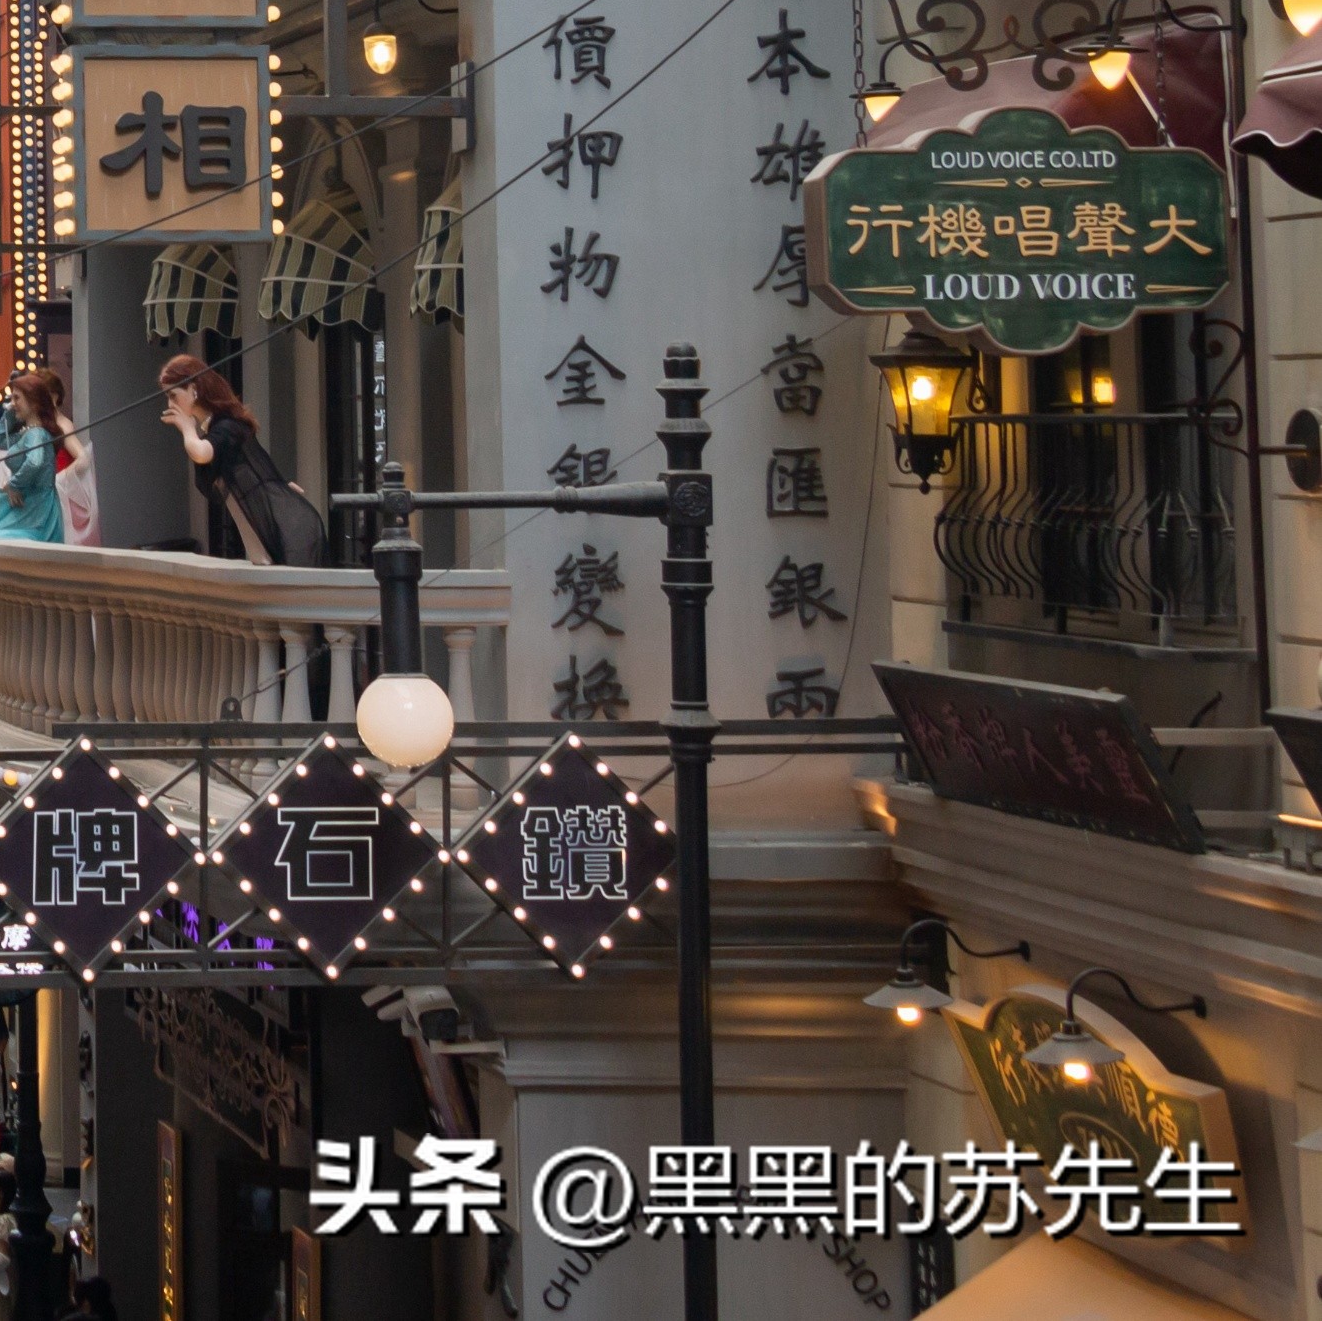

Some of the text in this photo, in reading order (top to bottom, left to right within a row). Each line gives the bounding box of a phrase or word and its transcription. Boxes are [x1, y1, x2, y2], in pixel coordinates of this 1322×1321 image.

[931, 150, 1117, 169] LOUD VOICE CO.LTD
[846, 201, 1214, 260] 大聲唱機行
[923, 272, 1137, 301] LOUD VOICE
